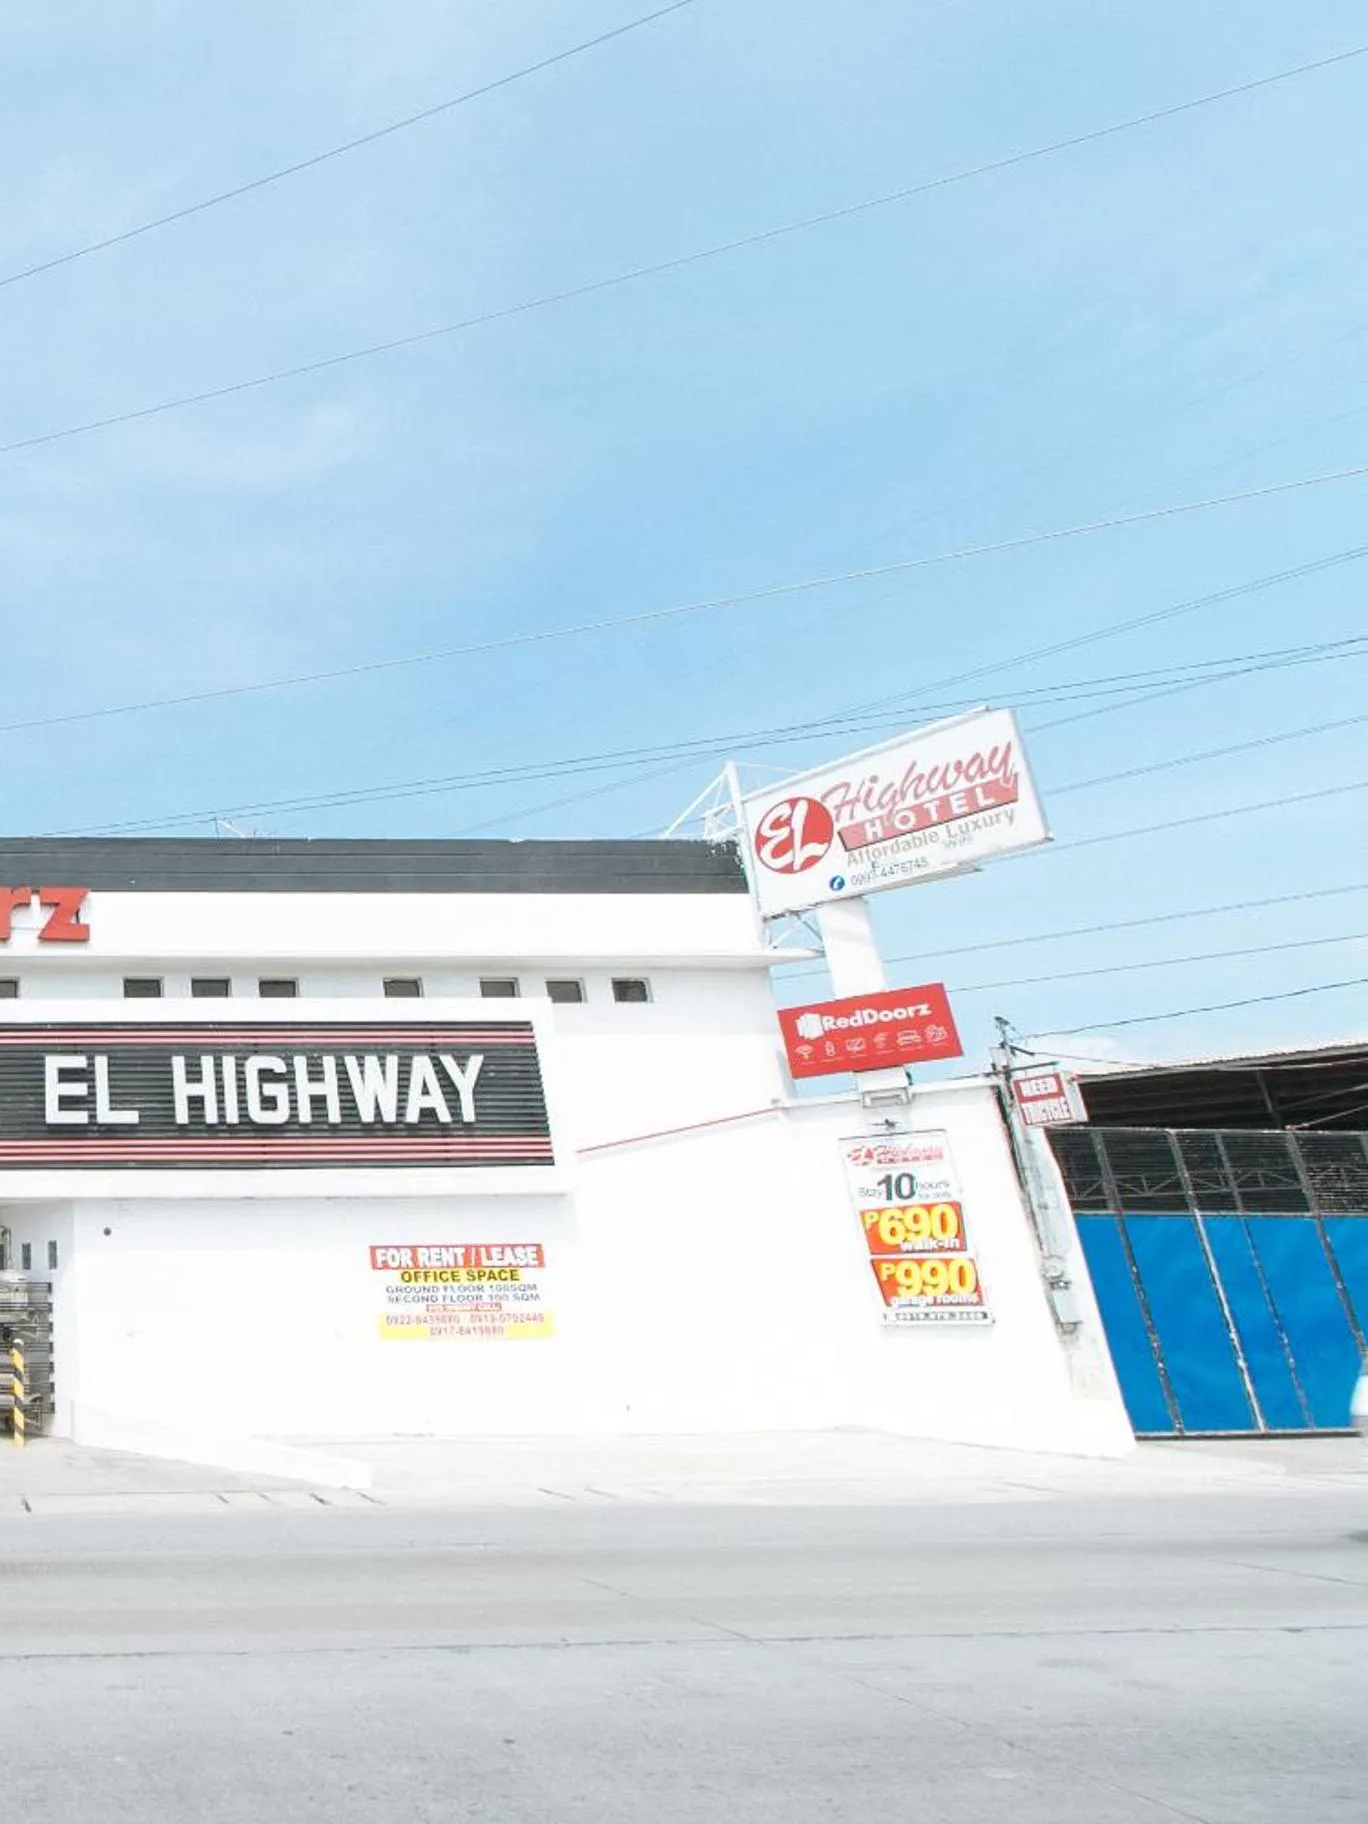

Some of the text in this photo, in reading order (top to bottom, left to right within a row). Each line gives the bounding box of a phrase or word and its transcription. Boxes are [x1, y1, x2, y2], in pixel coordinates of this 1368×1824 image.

[821, 741, 1016, 823] Highway
[863, 787, 996, 842] HOTEL
[846, 830, 939, 867] Affordable
[945, 807, 1016, 840] Luxury
[823, 1003, 931, 1031] RedDoorz
[43, 1054, 485, 1127] EL HIGHWAY
[876, 1172, 917, 1200] 10
[376, 1248, 412, 1267] FOR
[418, 1247, 465, 1267] RENT
[481, 1245, 538, 1266] LEASE
[386, 1284, 439, 1294] GROUND
[443, 1284, 485, 1294] FLOOR
[400, 1269, 520, 1283] OFFICE SPACE
[387, 1294, 439, 1304] SECOND
[442, 1293, 484, 1303] FLOOR
